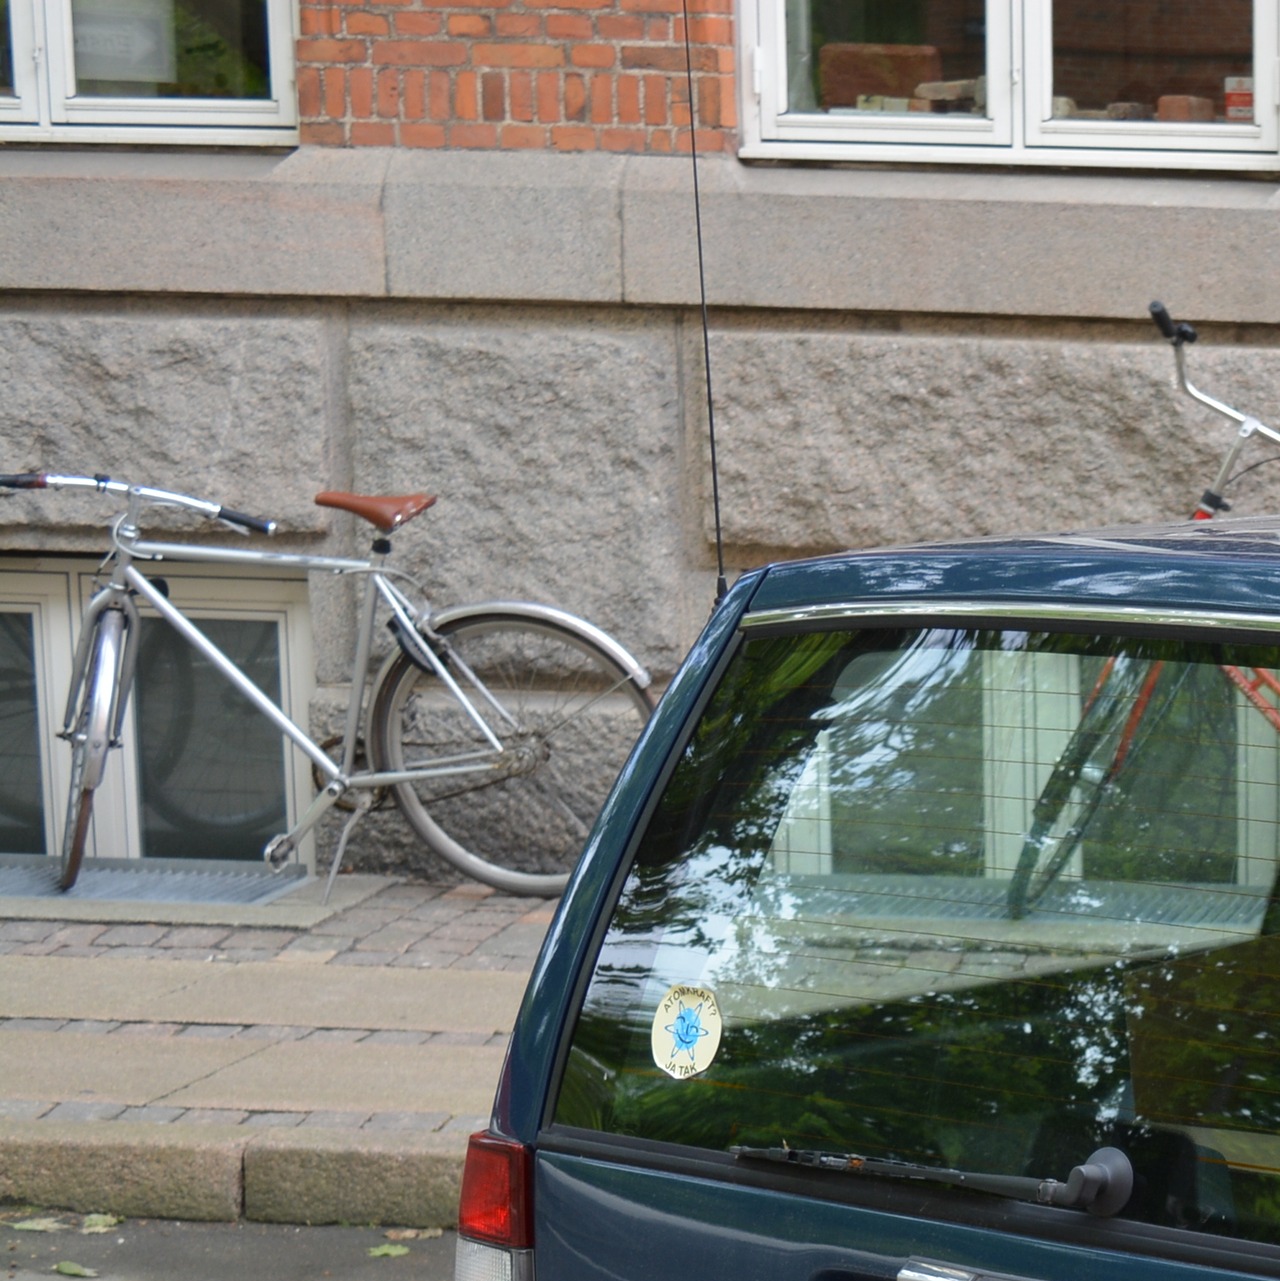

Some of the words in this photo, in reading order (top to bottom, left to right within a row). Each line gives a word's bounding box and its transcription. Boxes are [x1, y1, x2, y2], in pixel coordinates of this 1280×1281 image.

[664, 986, 717, 1017] ATOMKRAFT?
[665, 1061, 676, 1075] JA
[678, 1063, 698, 1076] TAK
